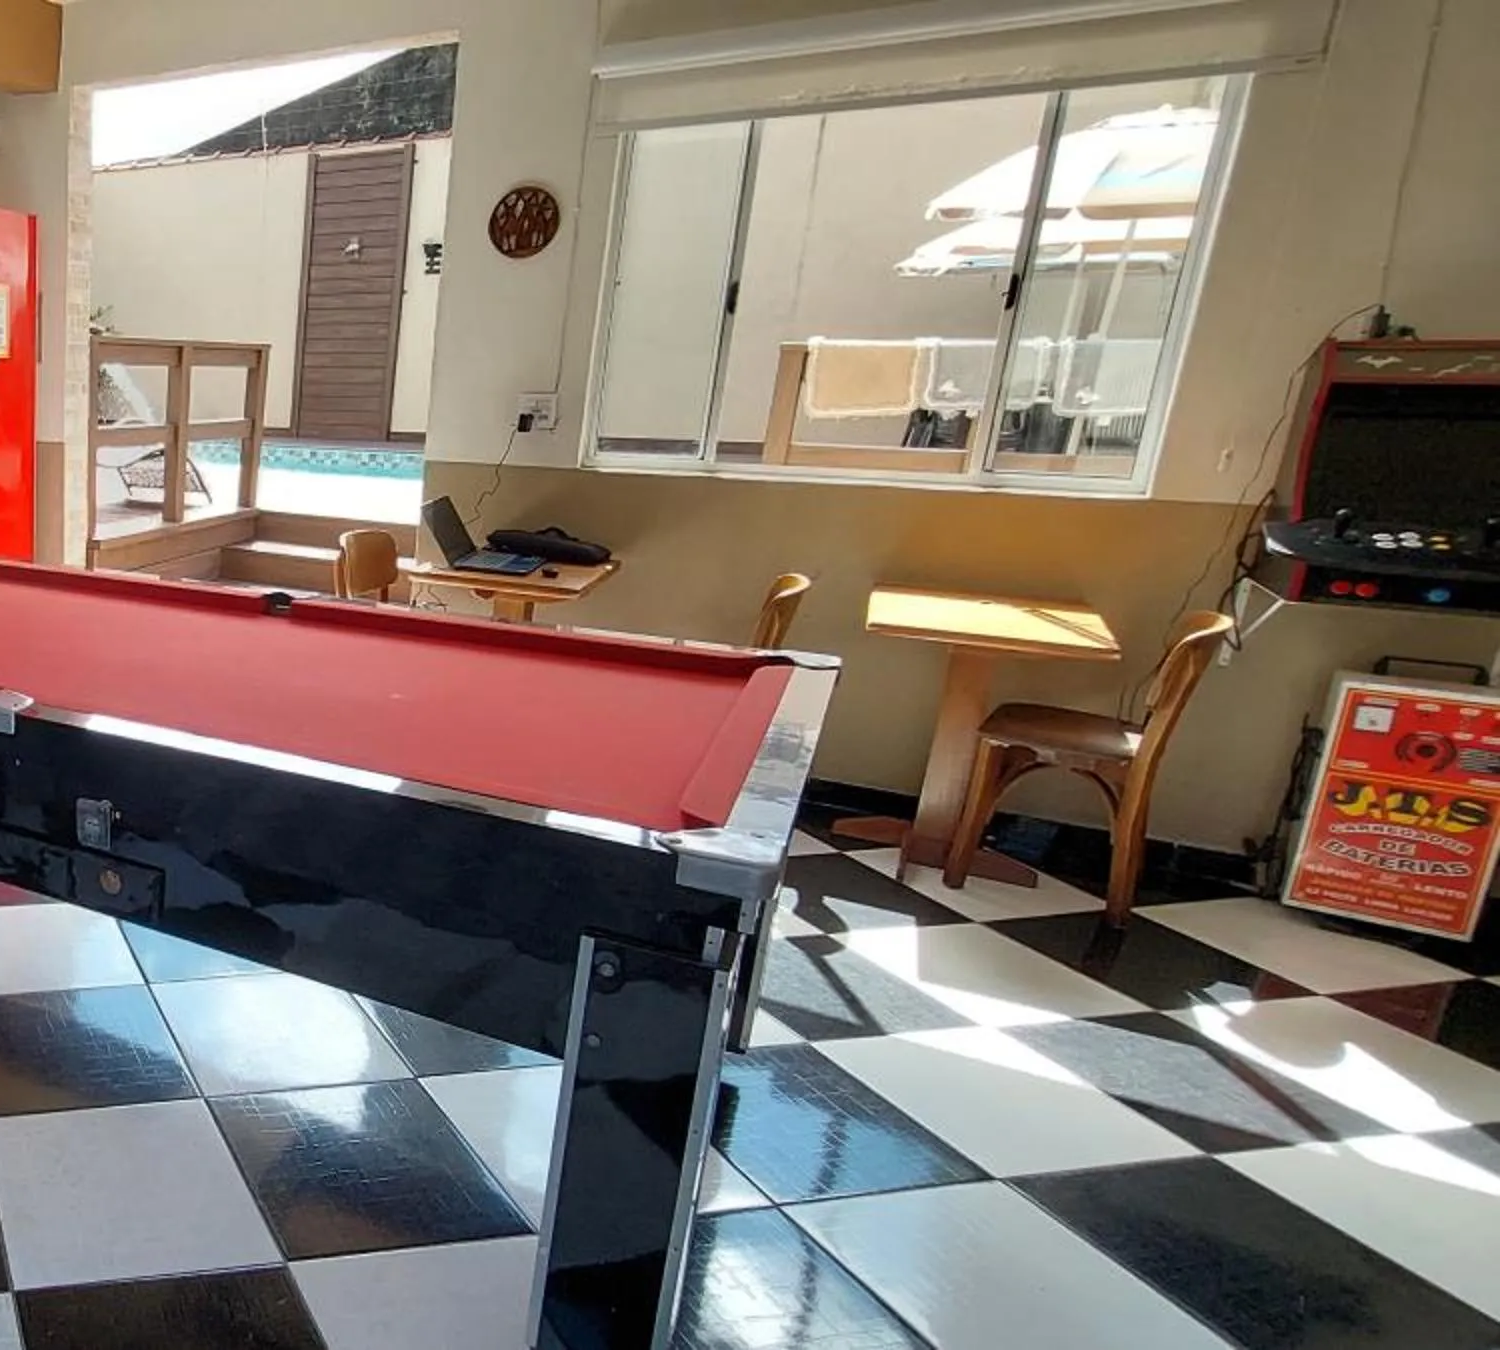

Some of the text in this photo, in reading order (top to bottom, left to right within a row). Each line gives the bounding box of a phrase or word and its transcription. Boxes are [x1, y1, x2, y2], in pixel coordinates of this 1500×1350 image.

[1328, 822, 1475, 857] CARREGADOR
[1379, 838, 1417, 857] DE
[1322, 838, 1473, 878] BATERIAS
